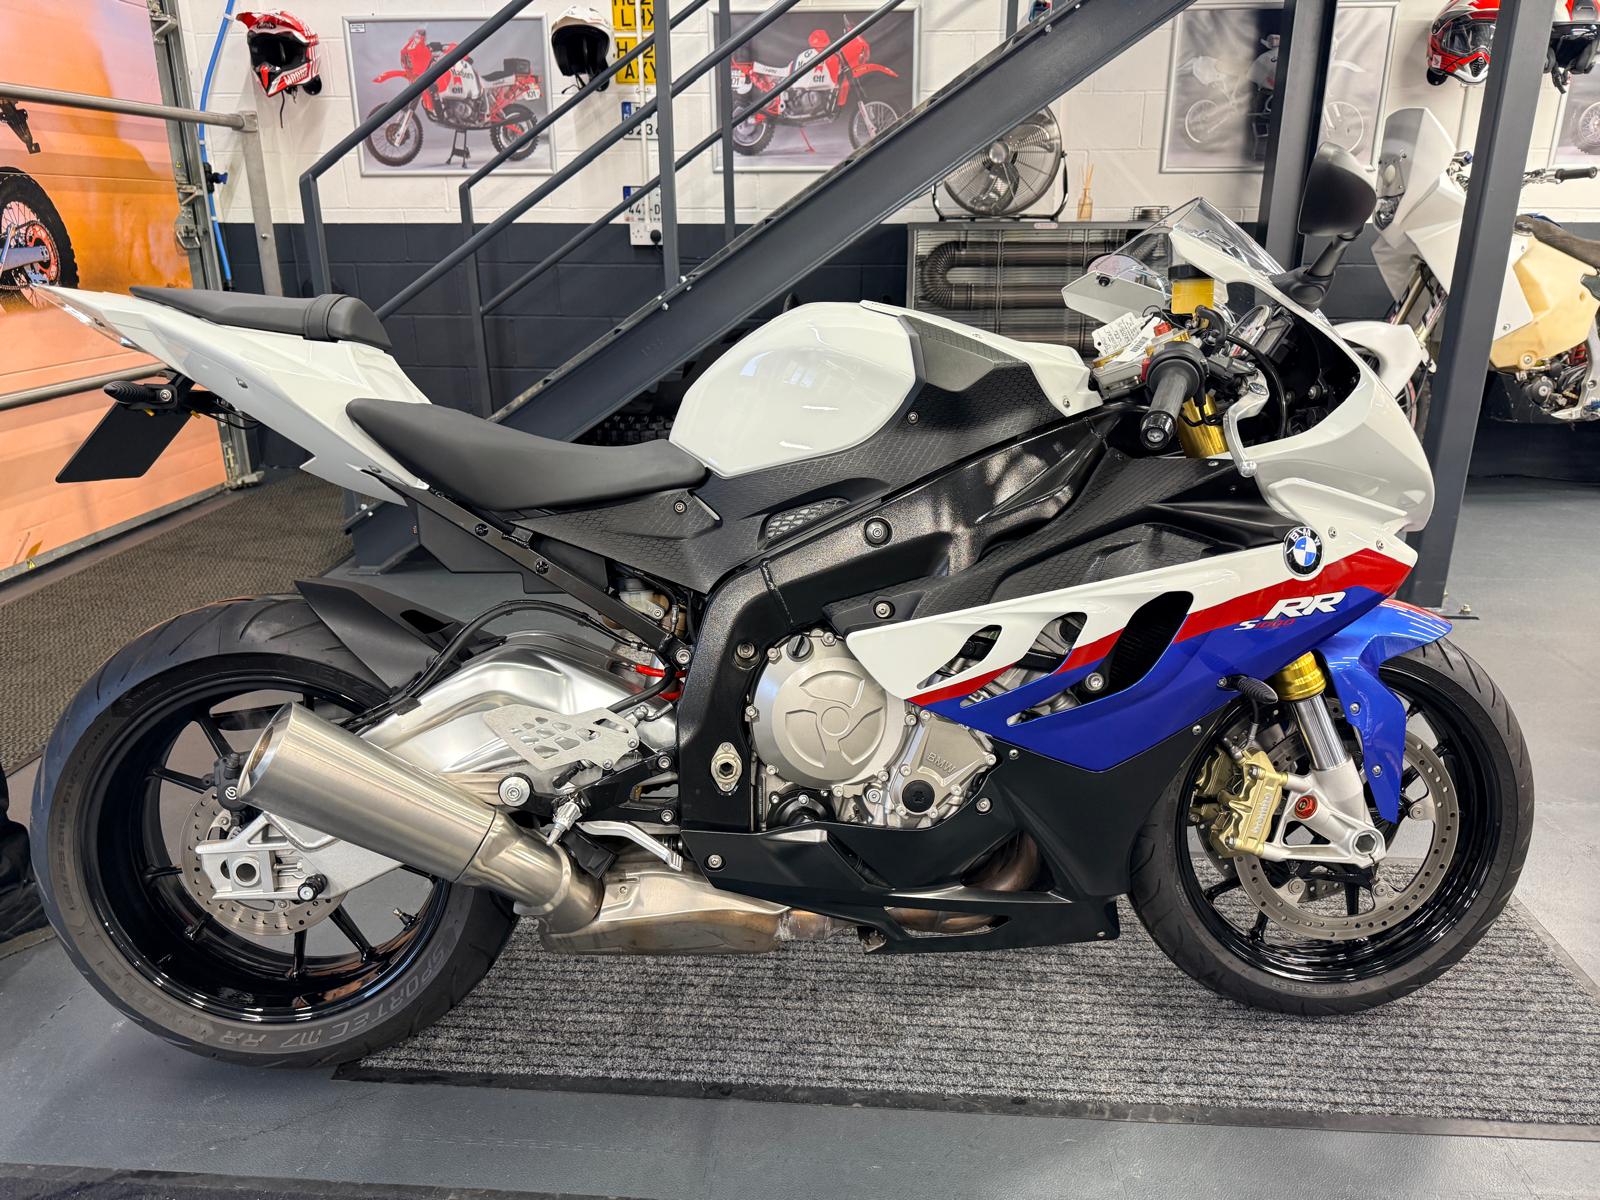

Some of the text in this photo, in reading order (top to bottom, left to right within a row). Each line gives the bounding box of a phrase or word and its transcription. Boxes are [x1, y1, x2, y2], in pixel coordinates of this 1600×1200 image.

[1290, 528, 1322, 546] BMW
[1262, 591, 1347, 620] RR
[927, 752, 957, 774] BMW
[328, 949, 447, 1040] SPORTEC
[1271, 979, 1341, 995] METZELER
[219, 1030, 267, 1047] RR
